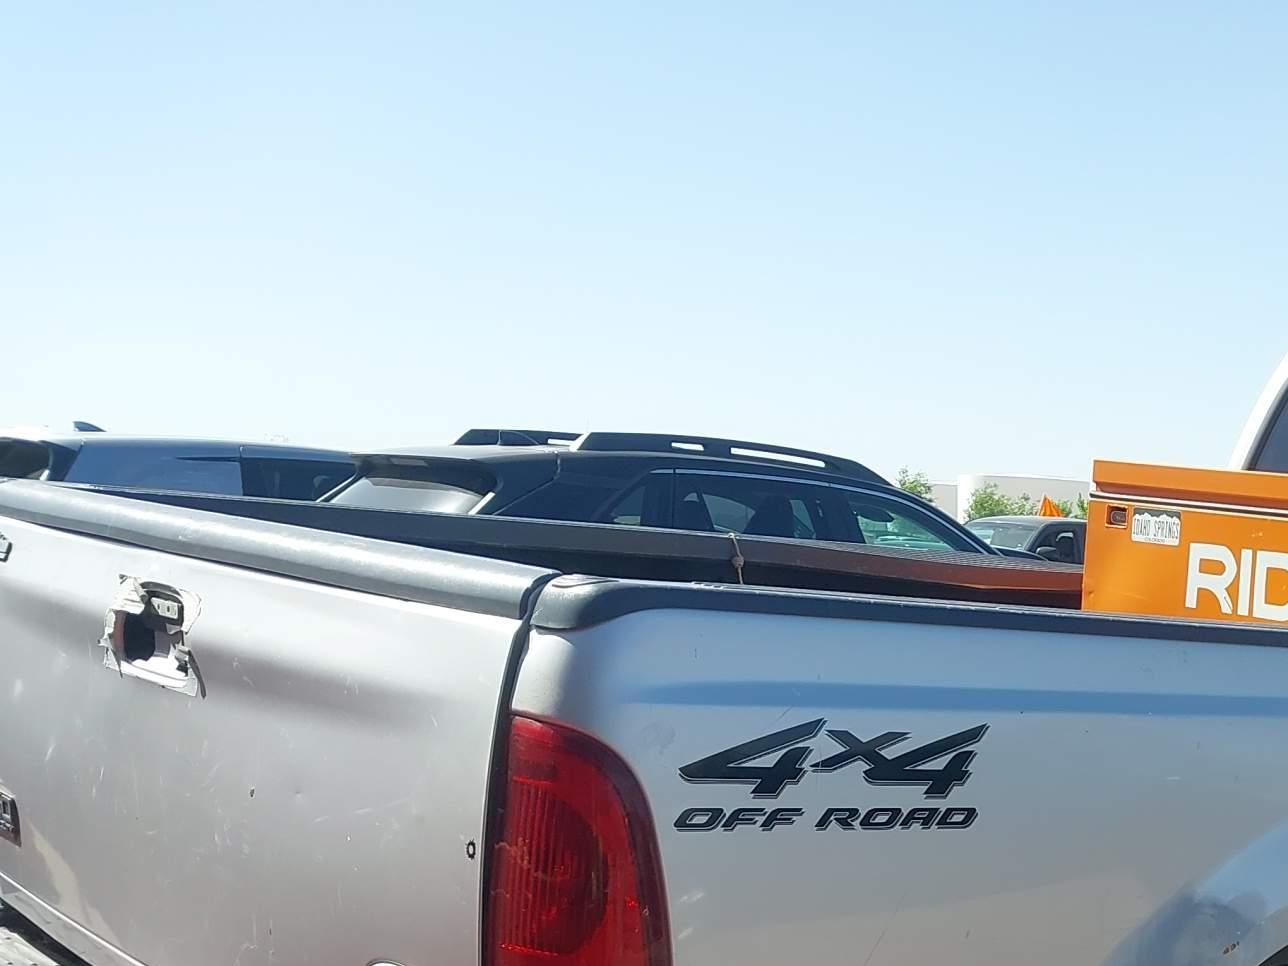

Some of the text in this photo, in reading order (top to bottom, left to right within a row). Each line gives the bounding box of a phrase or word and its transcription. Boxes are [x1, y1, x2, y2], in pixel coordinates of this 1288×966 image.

[1152, 519, 1180, 540] SPRINGS
[673, 807, 979, 832] OFF ROAD
